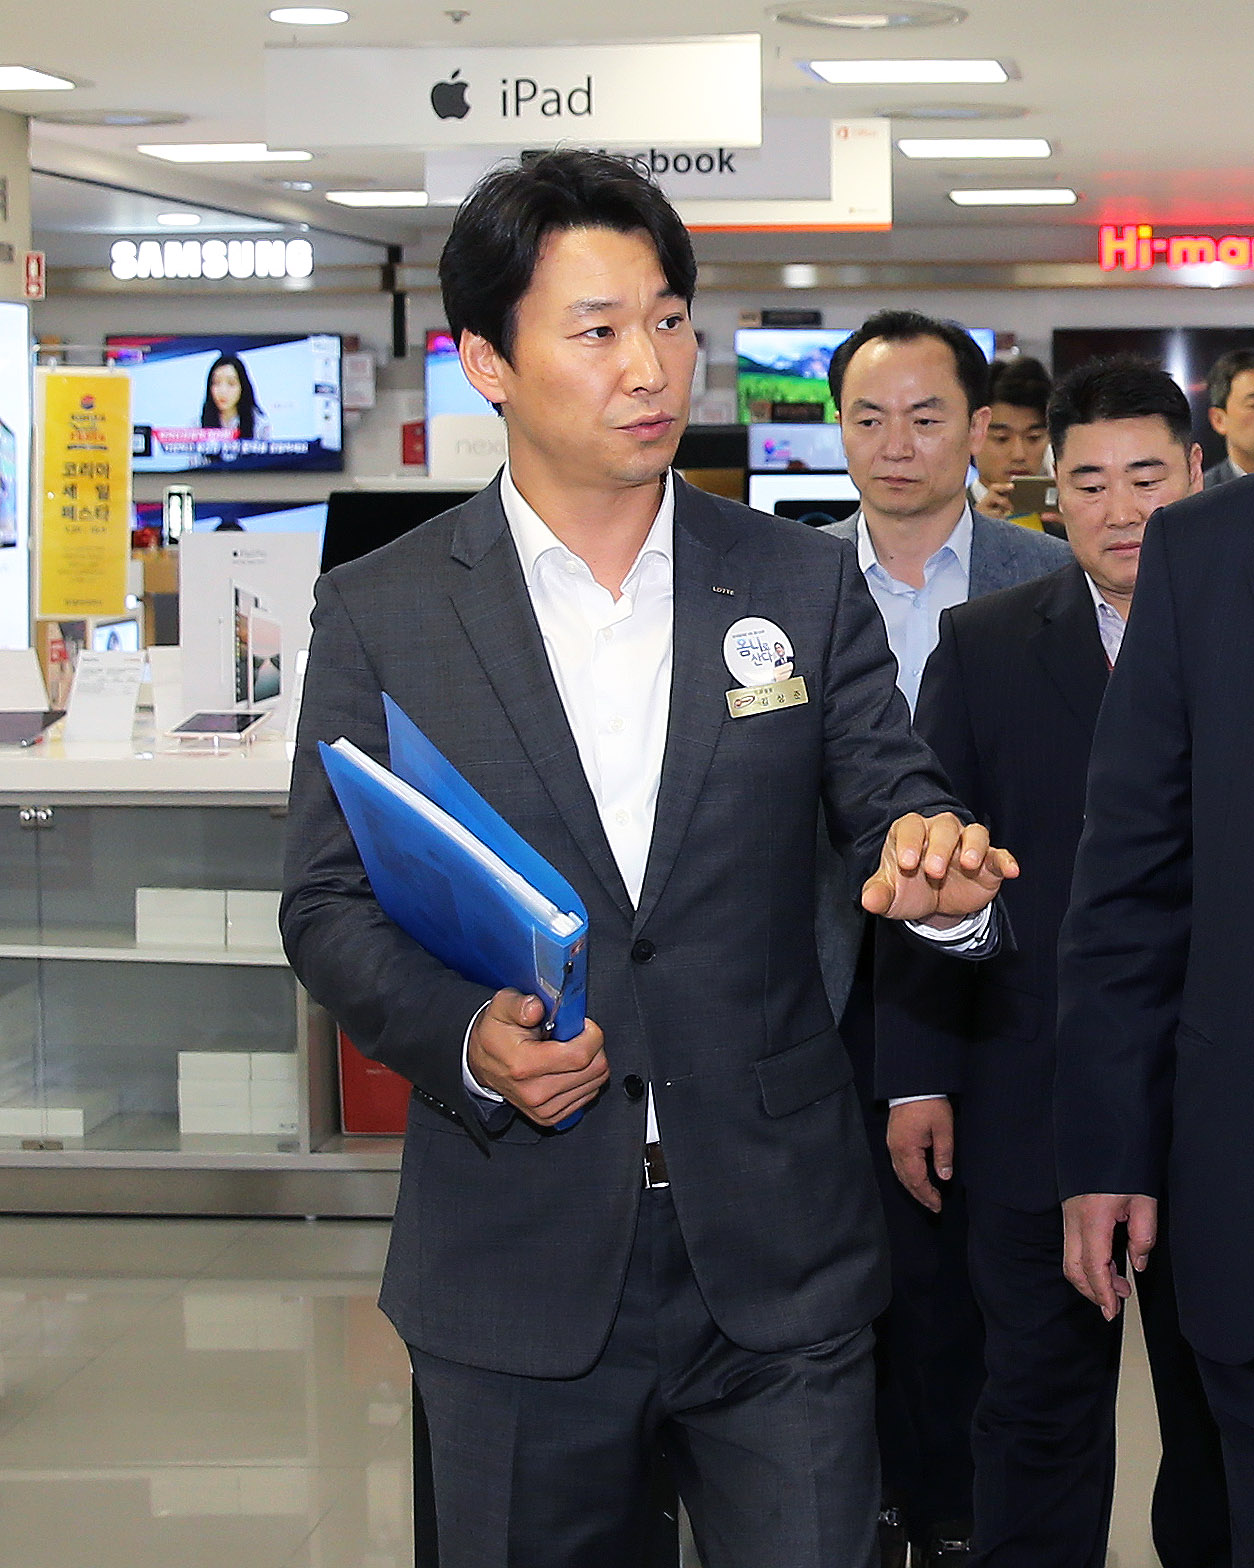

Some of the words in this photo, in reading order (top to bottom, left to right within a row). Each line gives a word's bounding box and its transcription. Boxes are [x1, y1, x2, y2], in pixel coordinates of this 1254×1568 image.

[500, 76, 594, 118] iPad
[630, 147, 735, 174] cbook
[111, 239, 314, 280] SAMSUNG
[63, 461, 110, 479] 코리아
[61, 505, 110, 521] 페스타
